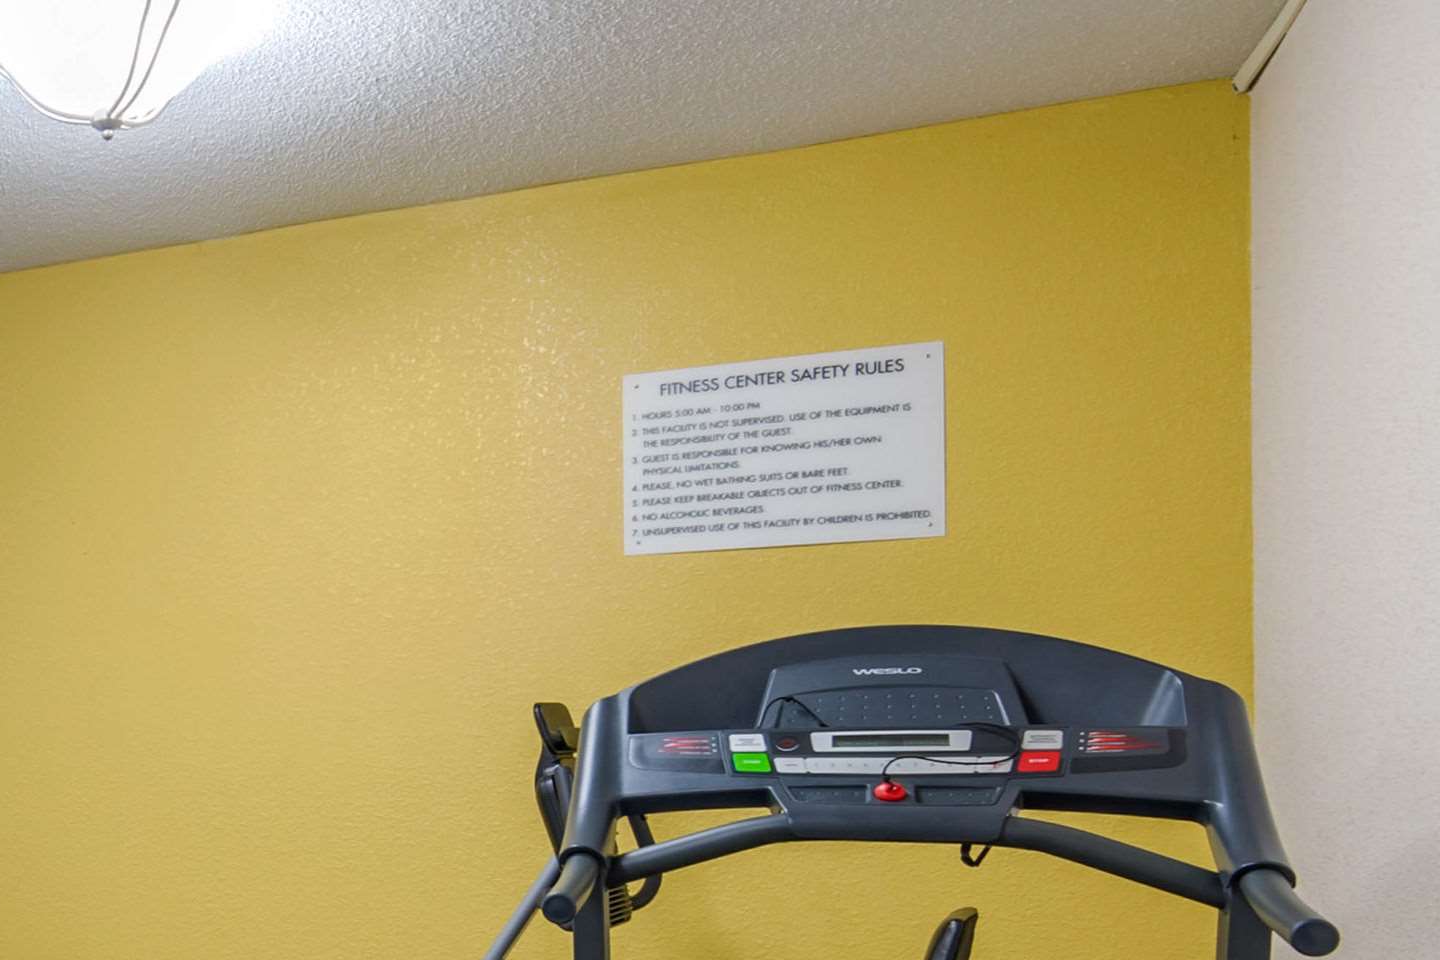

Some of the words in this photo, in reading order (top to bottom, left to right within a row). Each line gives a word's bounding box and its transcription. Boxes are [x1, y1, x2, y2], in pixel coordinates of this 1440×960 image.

[660, 378, 719, 396] FITNESS
[724, 371, 785, 389] CENTER
[791, 364, 850, 382] SAFETY
[855, 358, 904, 376] RULES
[663, 424, 697, 434] FACILITY
[699, 422, 707, 430] IS
[710, 420, 729, 429] NOT
[789, 411, 805, 422] USE
[810, 411, 822, 419] OF
[825, 409, 842, 418] THE
[845, 404, 900, 416] EQUIPMENT
[902, 403, 911, 411] IS
[696, 407, 711, 415] AM
[747, 402, 761, 410] PM
[642, 454, 669, 463] GUEST
[672, 453, 680, 461] IS
[682, 448, 738, 460] RESPONSIBLE
[741, 447, 758, 455] FOR
[761, 441, 810, 453] KNOWING
[813, 438, 851, 448] HIS/HER
[854, 436, 882, 445] OWN
[643, 439, 657, 448] THE
[660, 433, 726, 447] RESPONSIBILITY
[728, 432, 741, 441] OF
[744, 430, 757, 439] THE
[643, 466, 682, 476] PHYSICAL
[676, 480, 692, 488] NO
[716, 474, 757, 484] BATHING
[760, 472, 783, 481] SUITS
[785, 471, 799, 479] OR
[802, 469, 824, 478] BARE
[643, 497, 671, 506] PLEASE
[697, 491, 745, 501] BREAKABLE
[747, 488, 785, 498] OBJECTS
[788, 486, 808, 495] OUT
[810, 485, 824, 493] OF
[826, 483, 862, 492] FITNESS
[643, 512, 657, 521] NO
[660, 509, 711, 519] ALCOHOLIC
[643, 525, 706, 536] UNSUPERVISED
[709, 524, 724, 532] USE
[727, 522, 740, 531] OF
[744, 521, 761, 529] THIS
[764, 516, 800, 528] FACILITY
[803, 517, 815, 526] BY
[817, 514, 863, 525] CHILDREN
[865, 513, 873, 521] IS
